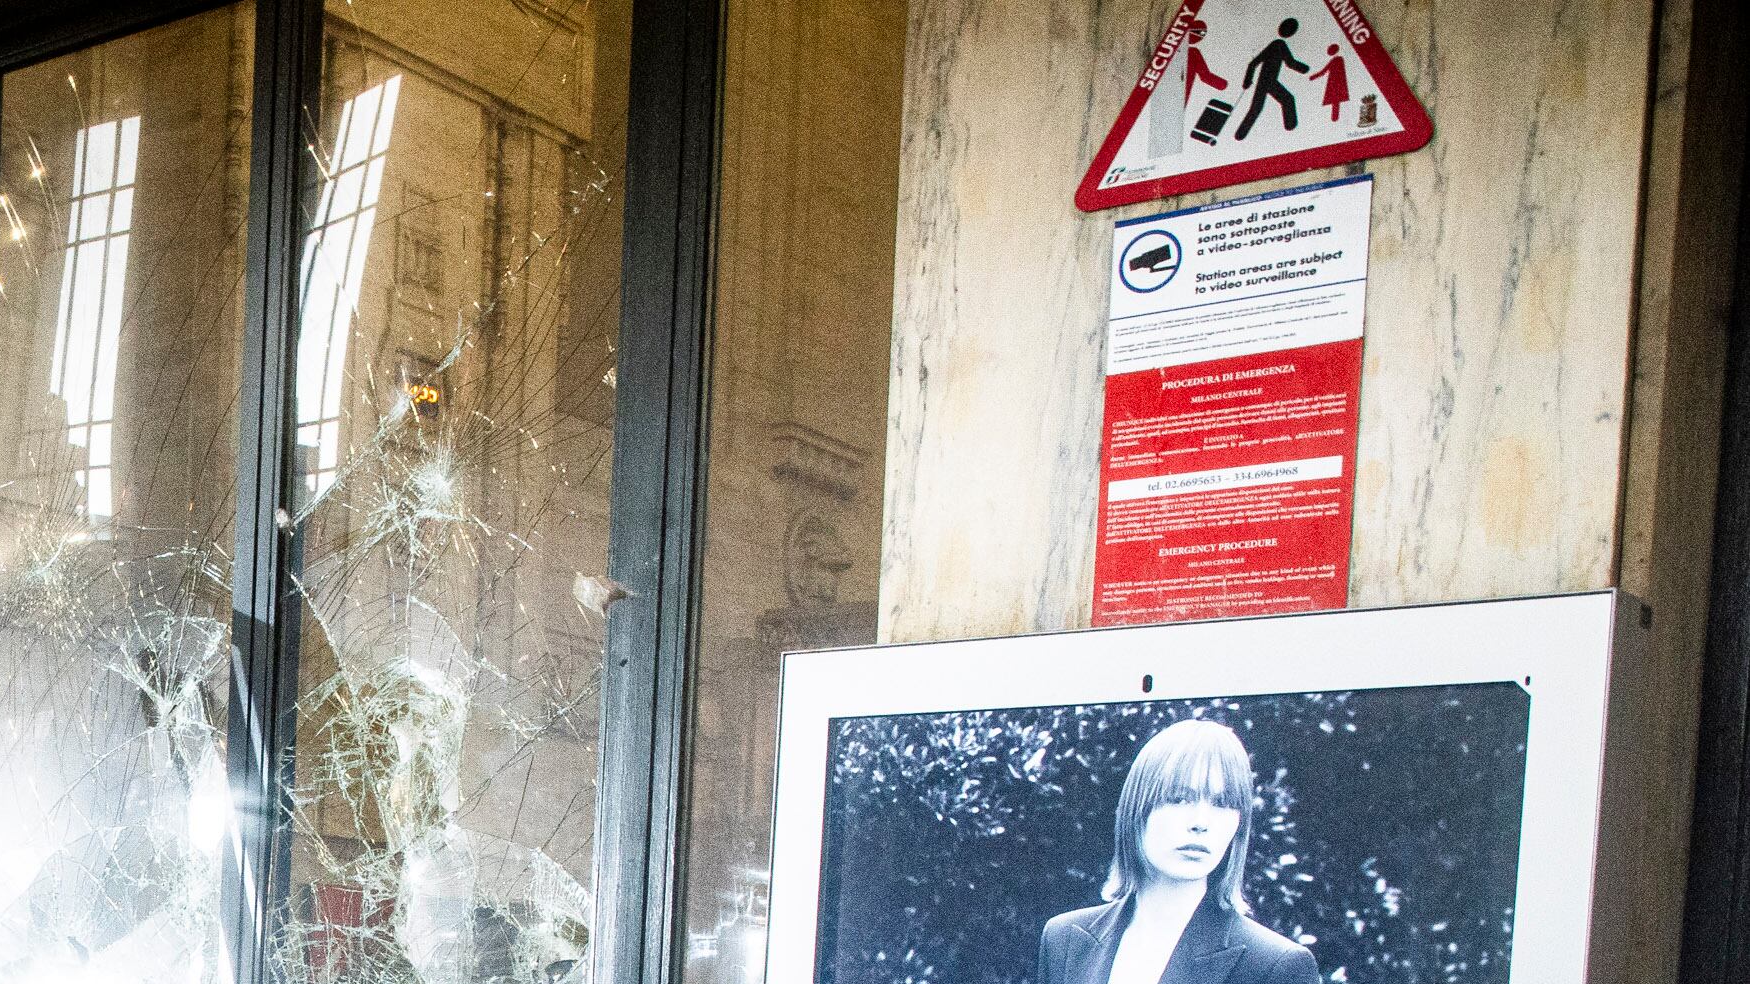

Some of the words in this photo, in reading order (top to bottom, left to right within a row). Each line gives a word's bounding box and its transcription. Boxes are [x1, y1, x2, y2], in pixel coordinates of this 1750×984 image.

[1329, 0, 1370, 45] NING
[1139, 4, 1195, 91] SECURITY
[1197, 233, 1227, 244] sono
[1230, 220, 1296, 239] sottoposte
[1198, 223, 1211, 232] Le
[1215, 217, 1243, 229] aree
[1246, 212, 1258, 223] di
[1261, 204, 1315, 220] stazione
[1196, 248, 1204, 256] a
[1195, 269, 1236, 283] Station
[1239, 262, 1273, 275] areas
[1276, 259, 1297, 270] are
[1299, 250, 1344, 265] subject
[1194, 286, 1206, 295] to
[1209, 280, 1242, 292] video
[1245, 267, 1318, 286] surveillance
[1161, 374, 1221, 391] PROCEDURA
[1222, 372, 1233, 382] DI
[1235, 363, 1296, 380] EMERGENZA
[1148, 481, 1162, 491] tel.
[1158, 543, 1216, 557] EMERGENCY
[1218, 538, 1278, 551] PROCEDURE
